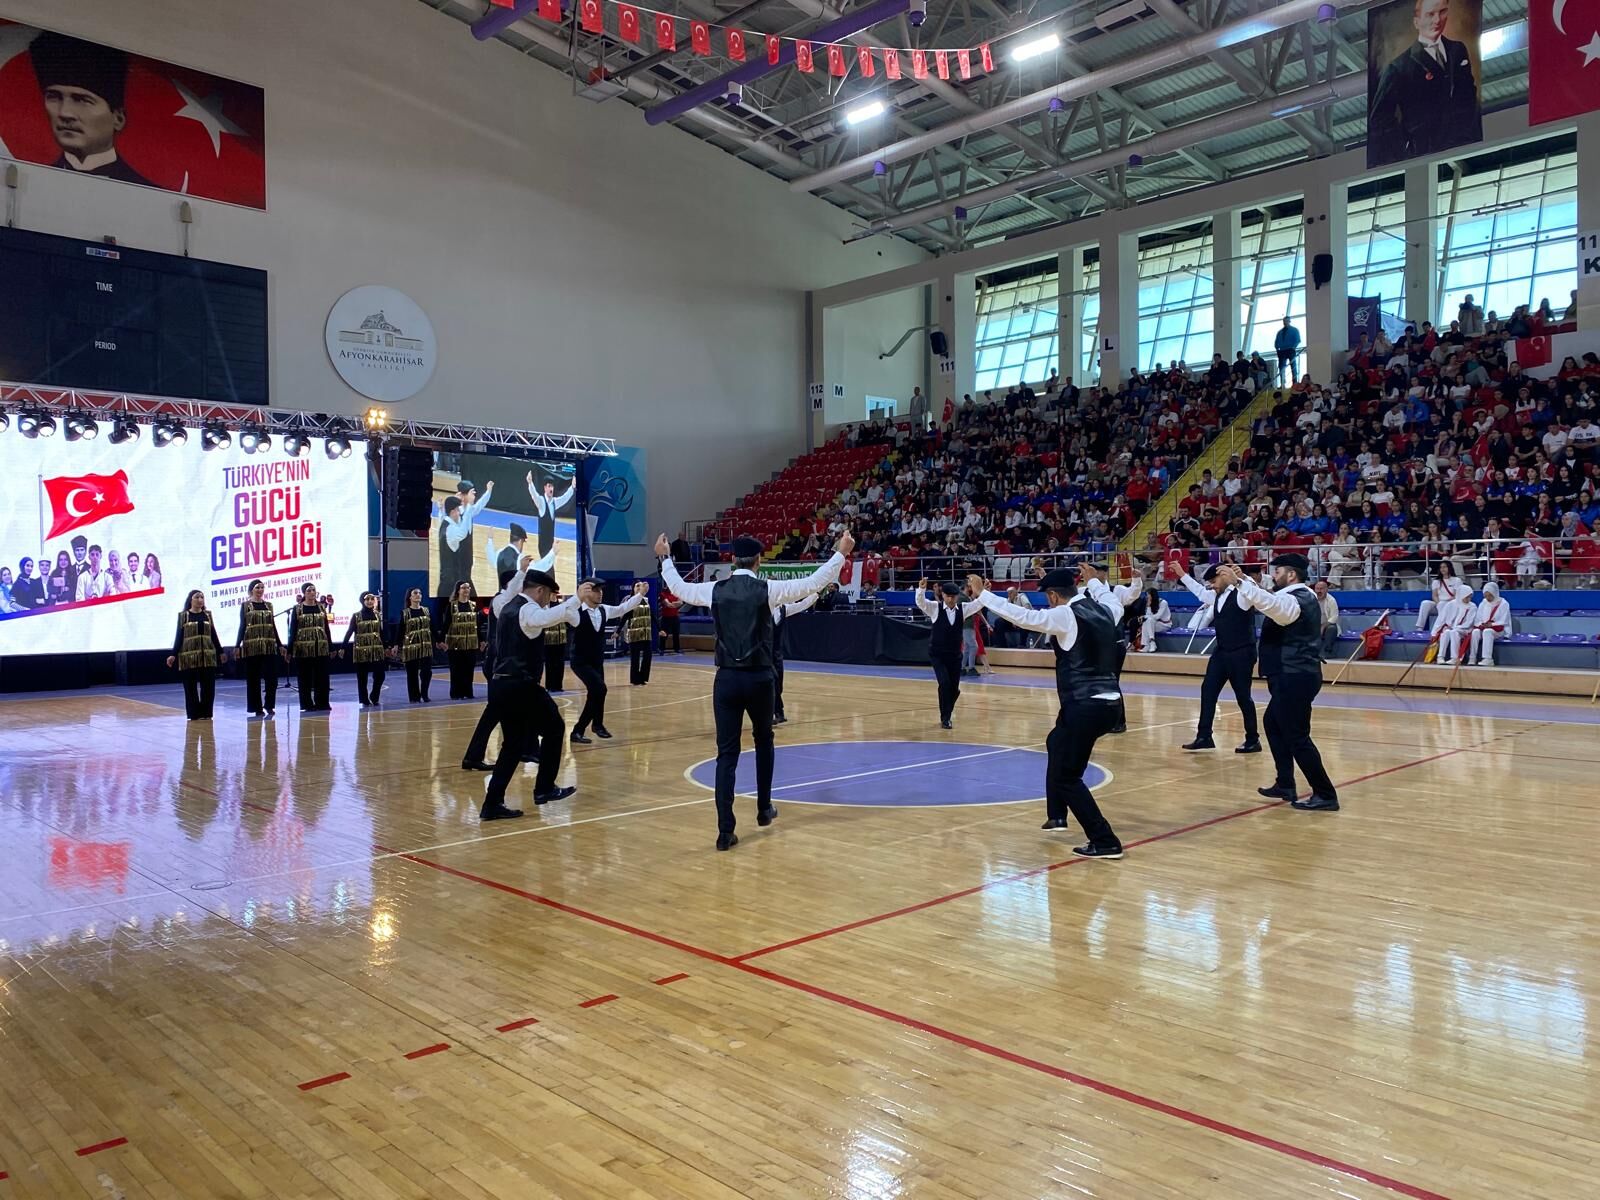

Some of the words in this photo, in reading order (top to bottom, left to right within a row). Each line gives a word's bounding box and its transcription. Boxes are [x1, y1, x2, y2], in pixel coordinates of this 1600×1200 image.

[1584, 256, 1600, 274] K
[95, 281, 113, 292] TIME
[94, 340, 117, 351] PERIOD
[1104, 338, 1114, 351] L
[940, 360, 955, 373] 111
[810, 384, 824, 395] 112
[834, 385, 843, 397] M
[813, 398, 823, 409] M
[222, 459, 310, 489] TÜRKİYE'NİN
[234, 486, 300, 528] GÜCÜ
[211, 520, 322, 572] GENÇLİĞİ
[219, 586, 239, 597] MAYIS
[273, 578, 290, 587] ANMA
[314, 572, 322, 580] VE
[220, 598, 236, 609] SPOR
[275, 588, 293, 599] KUTLU
